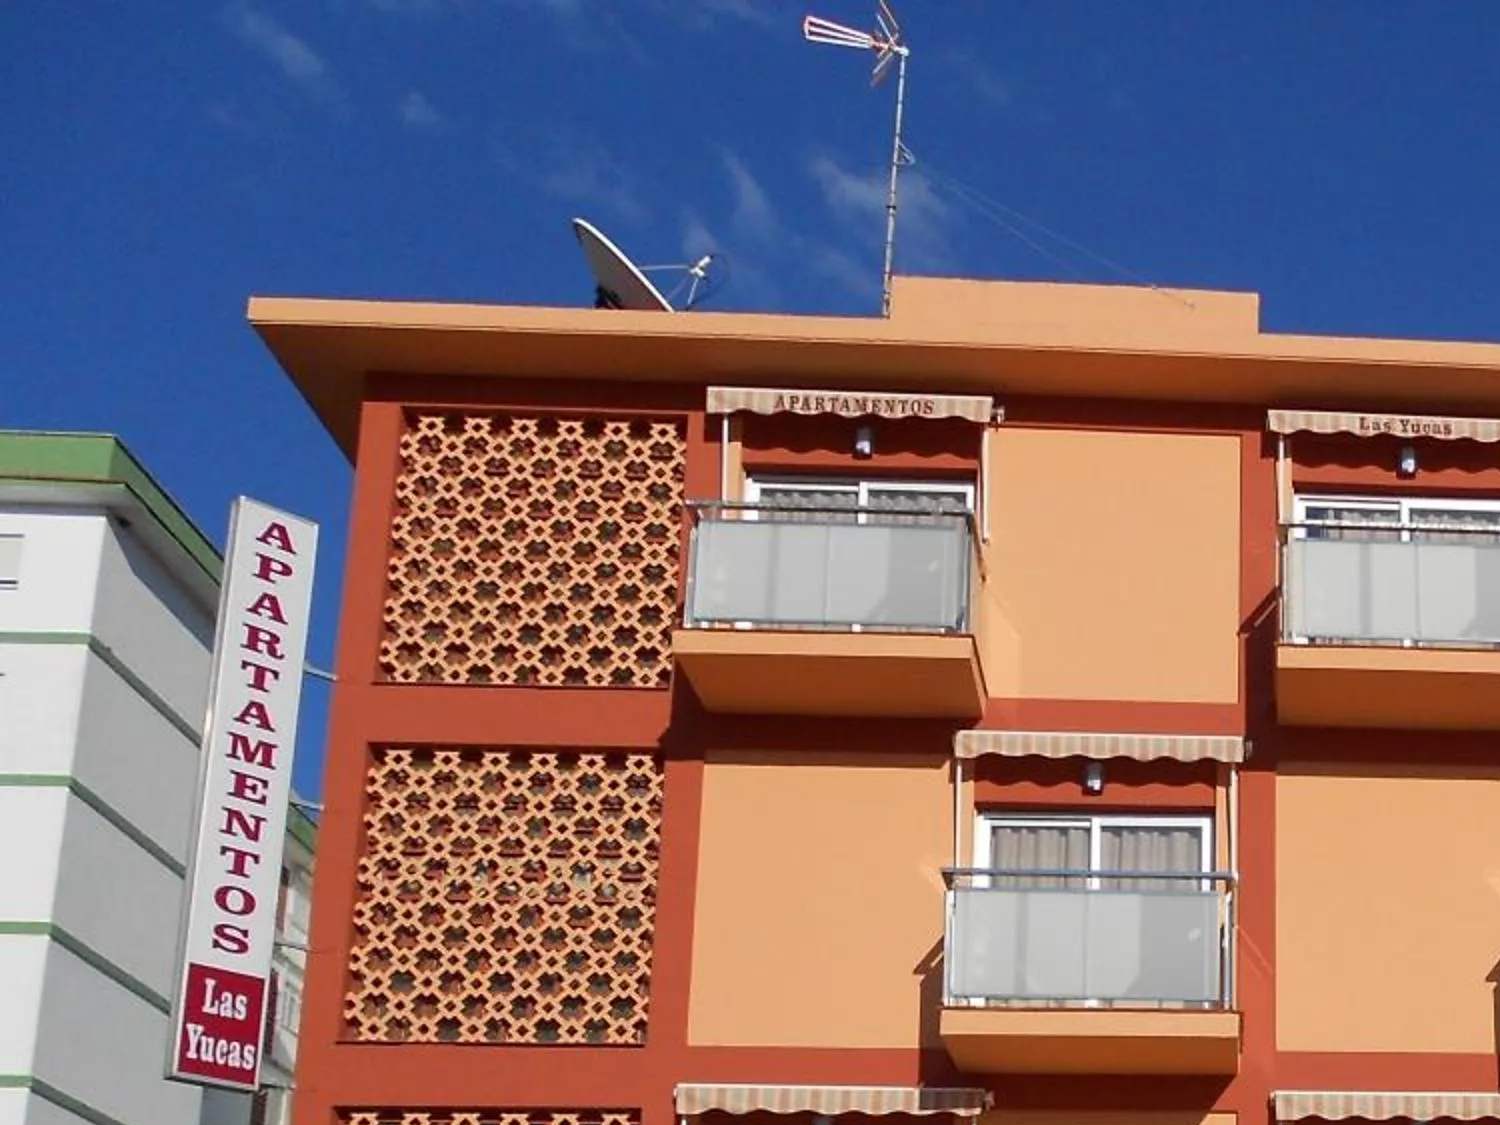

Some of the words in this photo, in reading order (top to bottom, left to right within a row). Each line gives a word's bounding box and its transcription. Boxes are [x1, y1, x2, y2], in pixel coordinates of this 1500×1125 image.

[774, 395, 935, 414] APARTAMENTOS
[1359, 416, 1392, 432] Las
[1399, 418, 1453, 435] Yucas
[213, 521, 297, 955] APARTAMENTOS
[202, 977, 247, 1021] Las
[185, 1022, 256, 1071] Yucas
